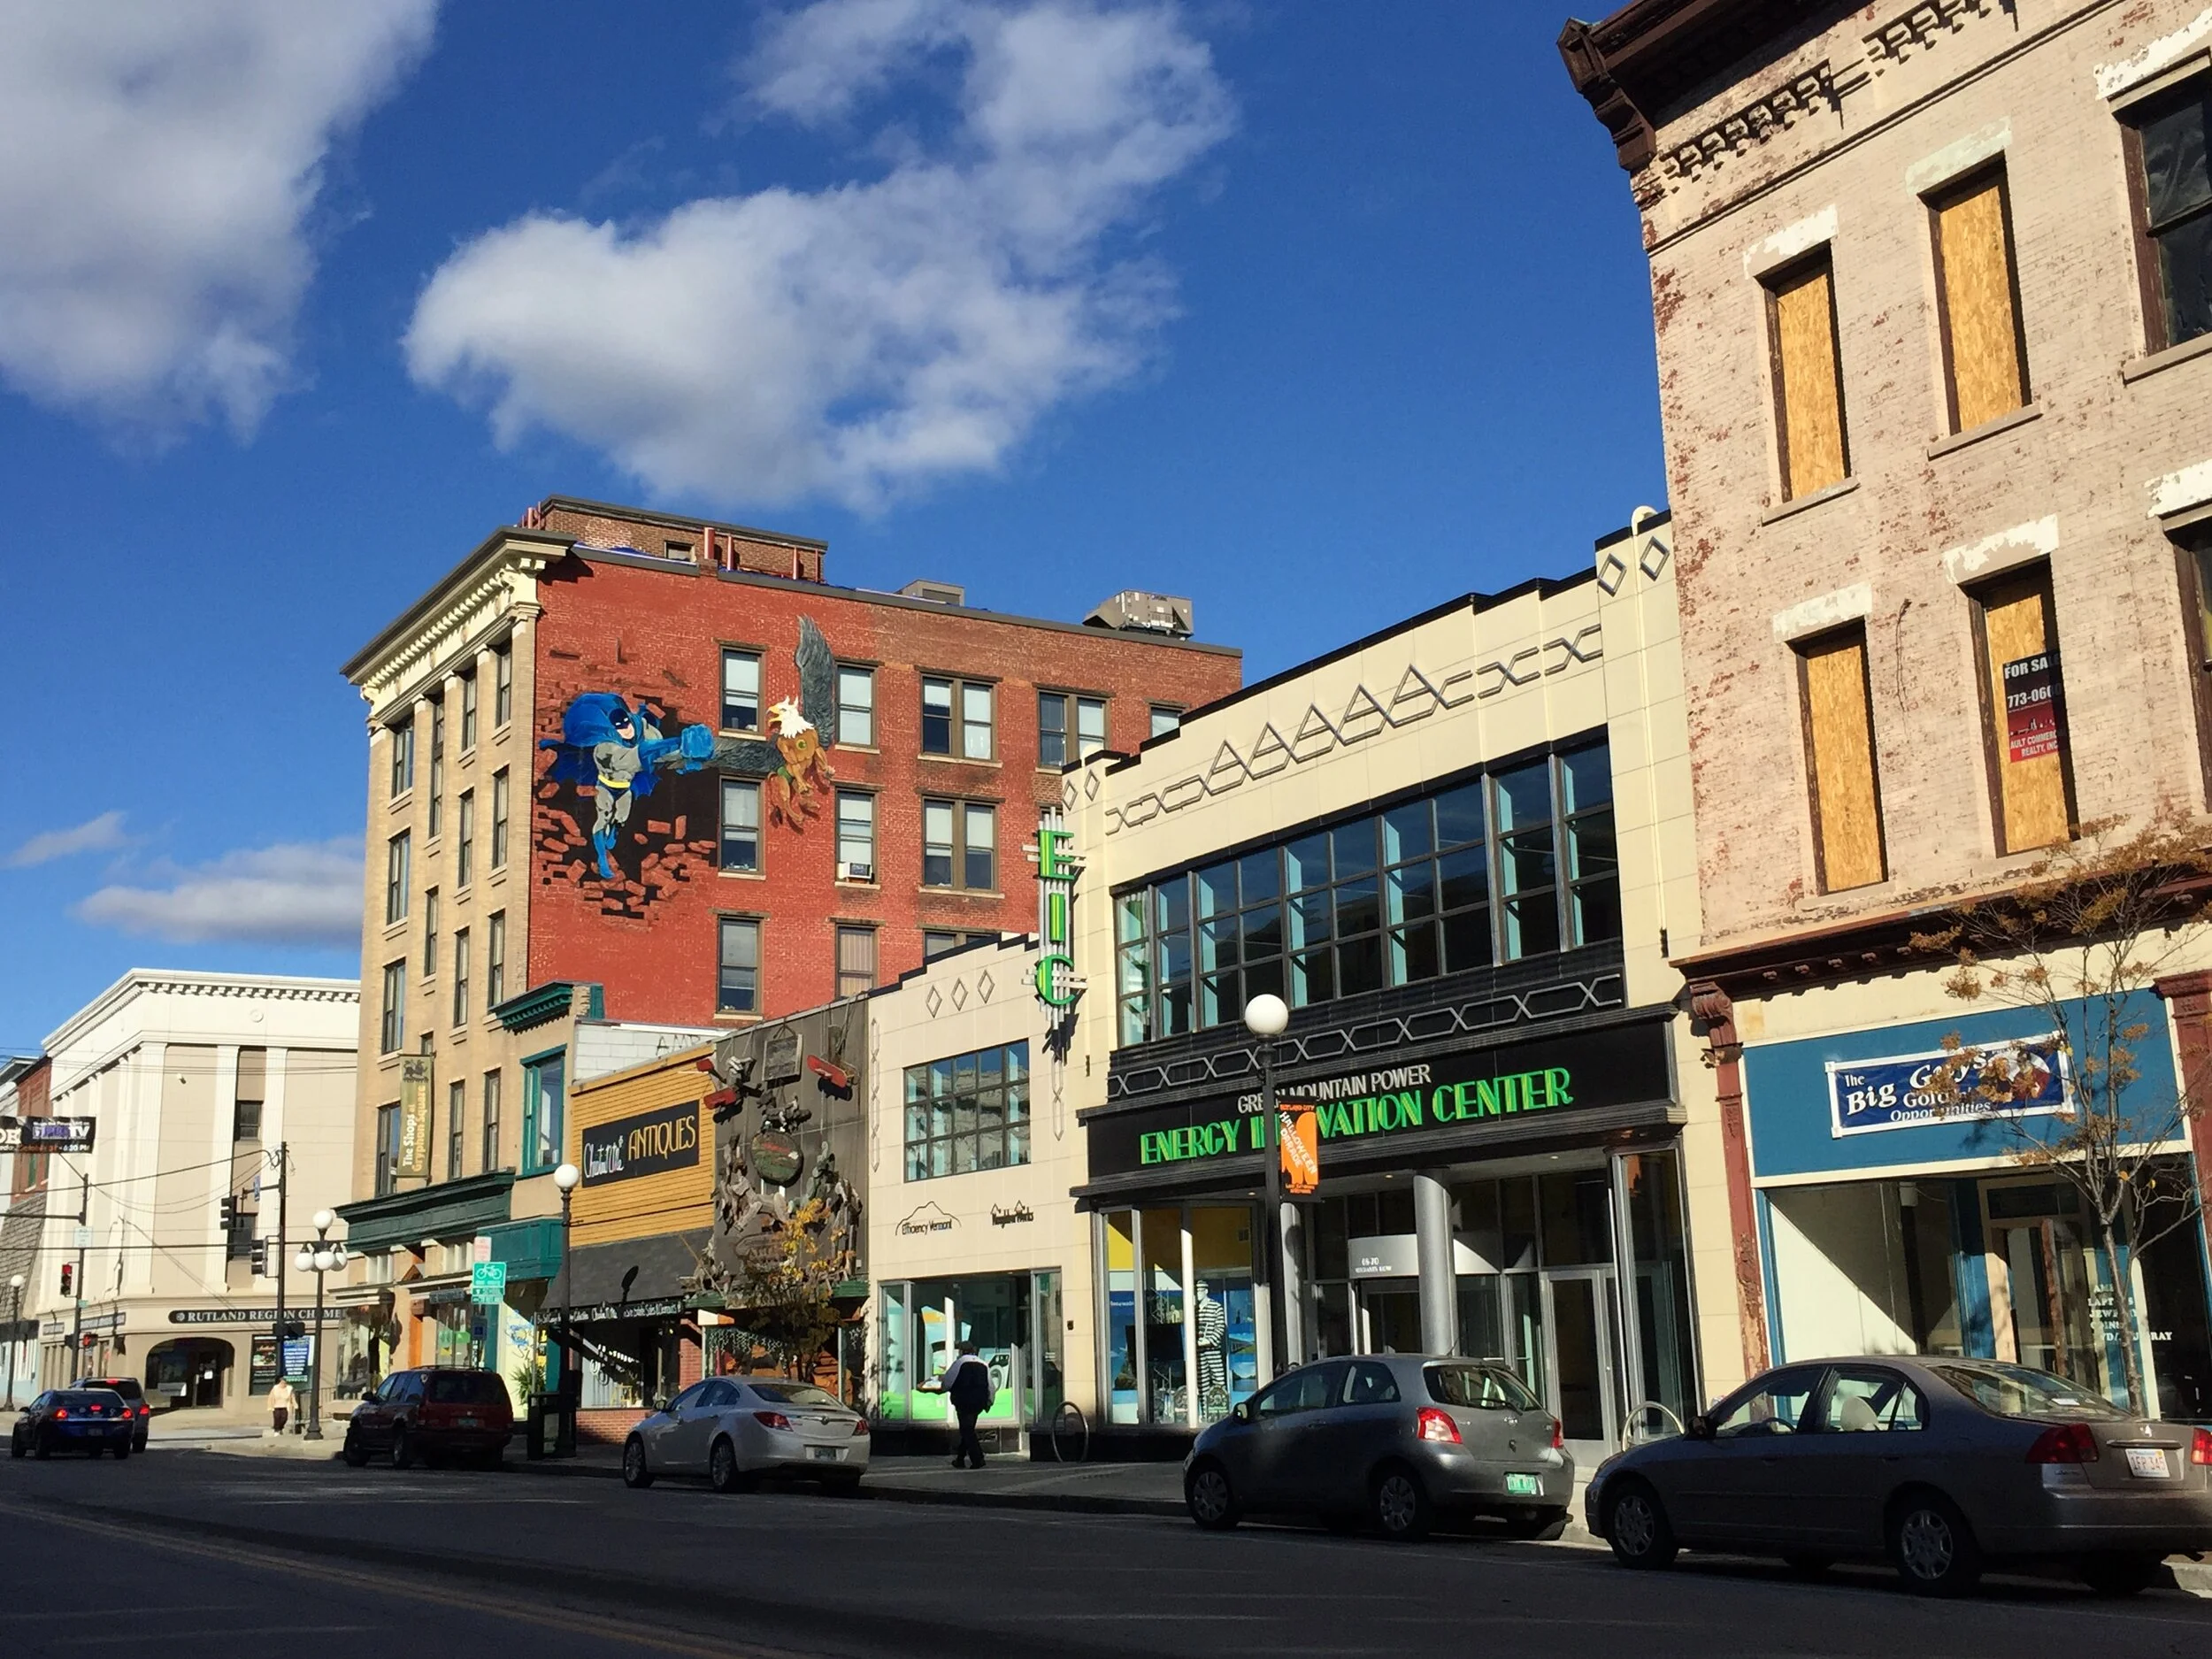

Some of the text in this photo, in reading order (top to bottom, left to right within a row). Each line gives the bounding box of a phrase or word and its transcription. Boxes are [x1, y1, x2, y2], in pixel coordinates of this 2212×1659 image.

[2004, 662, 2029, 680] FOR
[1035, 830, 1075, 1006] EIC
[1371, 1064, 1432, 1093] POWER
[1845, 1074, 1864, 1087] The
[1141, 1118, 1239, 1164] ENERGY
[1432, 1067, 1574, 1122] CENTER
[1846, 1083, 1897, 1116] Big
[403, 1114, 417, 1147] Shops
[411, 1085, 426, 1171] Gryphon Square
[628, 1115, 696, 1162] ANTIQUES
[1279, 1110, 1318, 1174] HALLOWEEN
[403, 1148, 413, 1166] The
[929, 1219, 953, 1232] Vermont
[188, 1310, 246, 1322] RUTLAND
